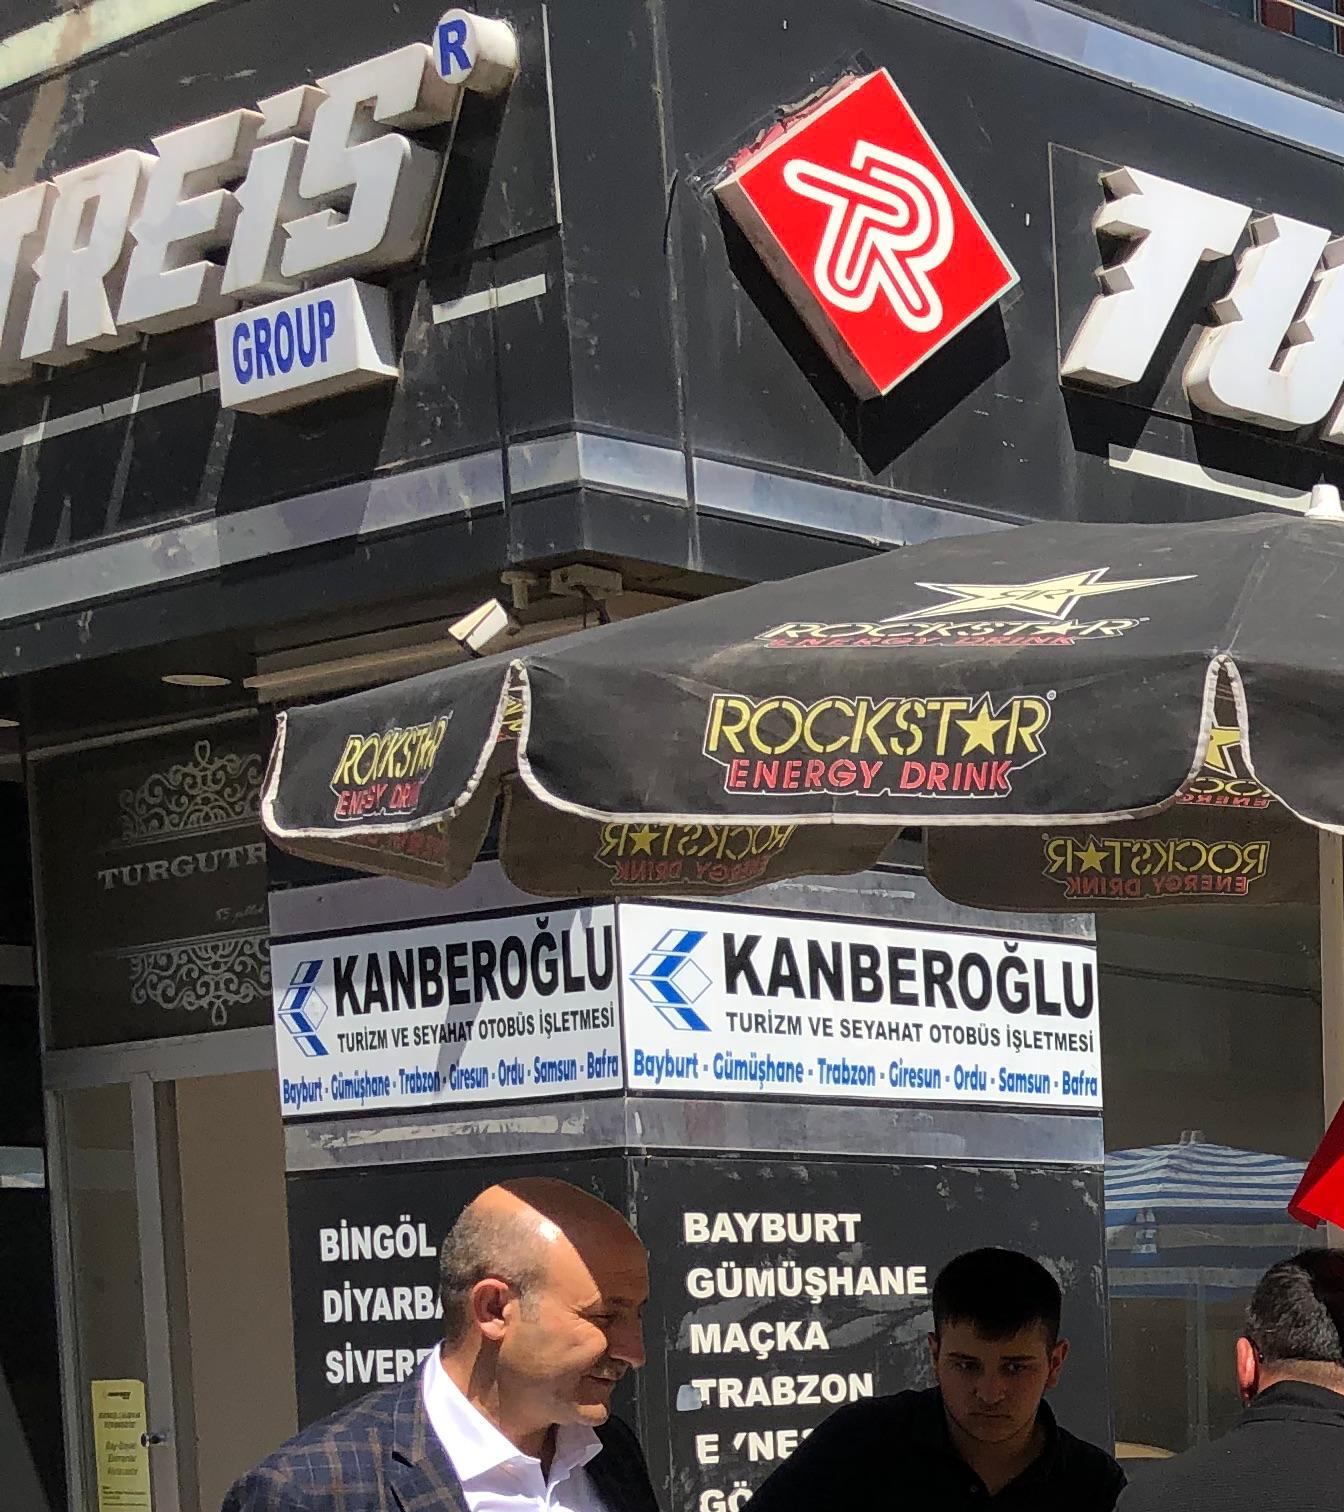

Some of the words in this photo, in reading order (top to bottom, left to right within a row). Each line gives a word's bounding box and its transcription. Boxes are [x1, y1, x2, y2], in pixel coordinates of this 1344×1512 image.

[232, 299, 335, 386] GROUP
[728, 759, 883, 790] ENERGY
[900, 760, 1011, 792] DRINK
[333, 916, 613, 1018] KANBEROĞLU
[722, 930, 1094, 1020] KANBEROĞLU
[337, 1025, 388, 1053] TURİZM
[392, 1025, 410, 1048] VE
[412, 1019, 473, 1045] SEYAHAT
[478, 1010, 536, 1040] OTOBÜS
[538, 1000, 615, 1040] İŞLETMESİ
[726, 1010, 803, 1036] TURİZM
[810, 1016, 835, 1038] VE
[839, 1018, 923, 1043] SEYAHAT
[929, 1020, 1001, 1047] OTOBÜS
[1006, 1024, 1095, 1056] İŞLETMESİ
[283, 1077, 322, 1110] Bayburt
[331, 1071, 391, 1106] Gümüşhane
[399, 1067, 441, 1093] Trabzon
[449, 1061, 489, 1091] Giresun
[499, 1058, 525, 1087] Ordu
[534, 1055, 577, 1084] Samsun
[587, 1051, 619, 1080] Bafra
[633, 1049, 699, 1082] Bayburt
[712, 1050, 804, 1089] Gümüşhane
[817, 1056, 876, 1085] Trabzon
[888, 1058, 941, 1087] Giresun
[953, 1061, 988, 1089] Ordu
[997, 1064, 1051, 1093] Samsun
[1061, 1066, 1098, 1097] Bafra
[320, 1214, 437, 1262] BİNGÖL
[684, 1212, 861, 1245] BAYBURT
[687, 1263, 928, 1306] GÜMÜŞHANE
[690, 1320, 829, 1362] MAÇKA
[693, 1372, 875, 1410] TRABZON
